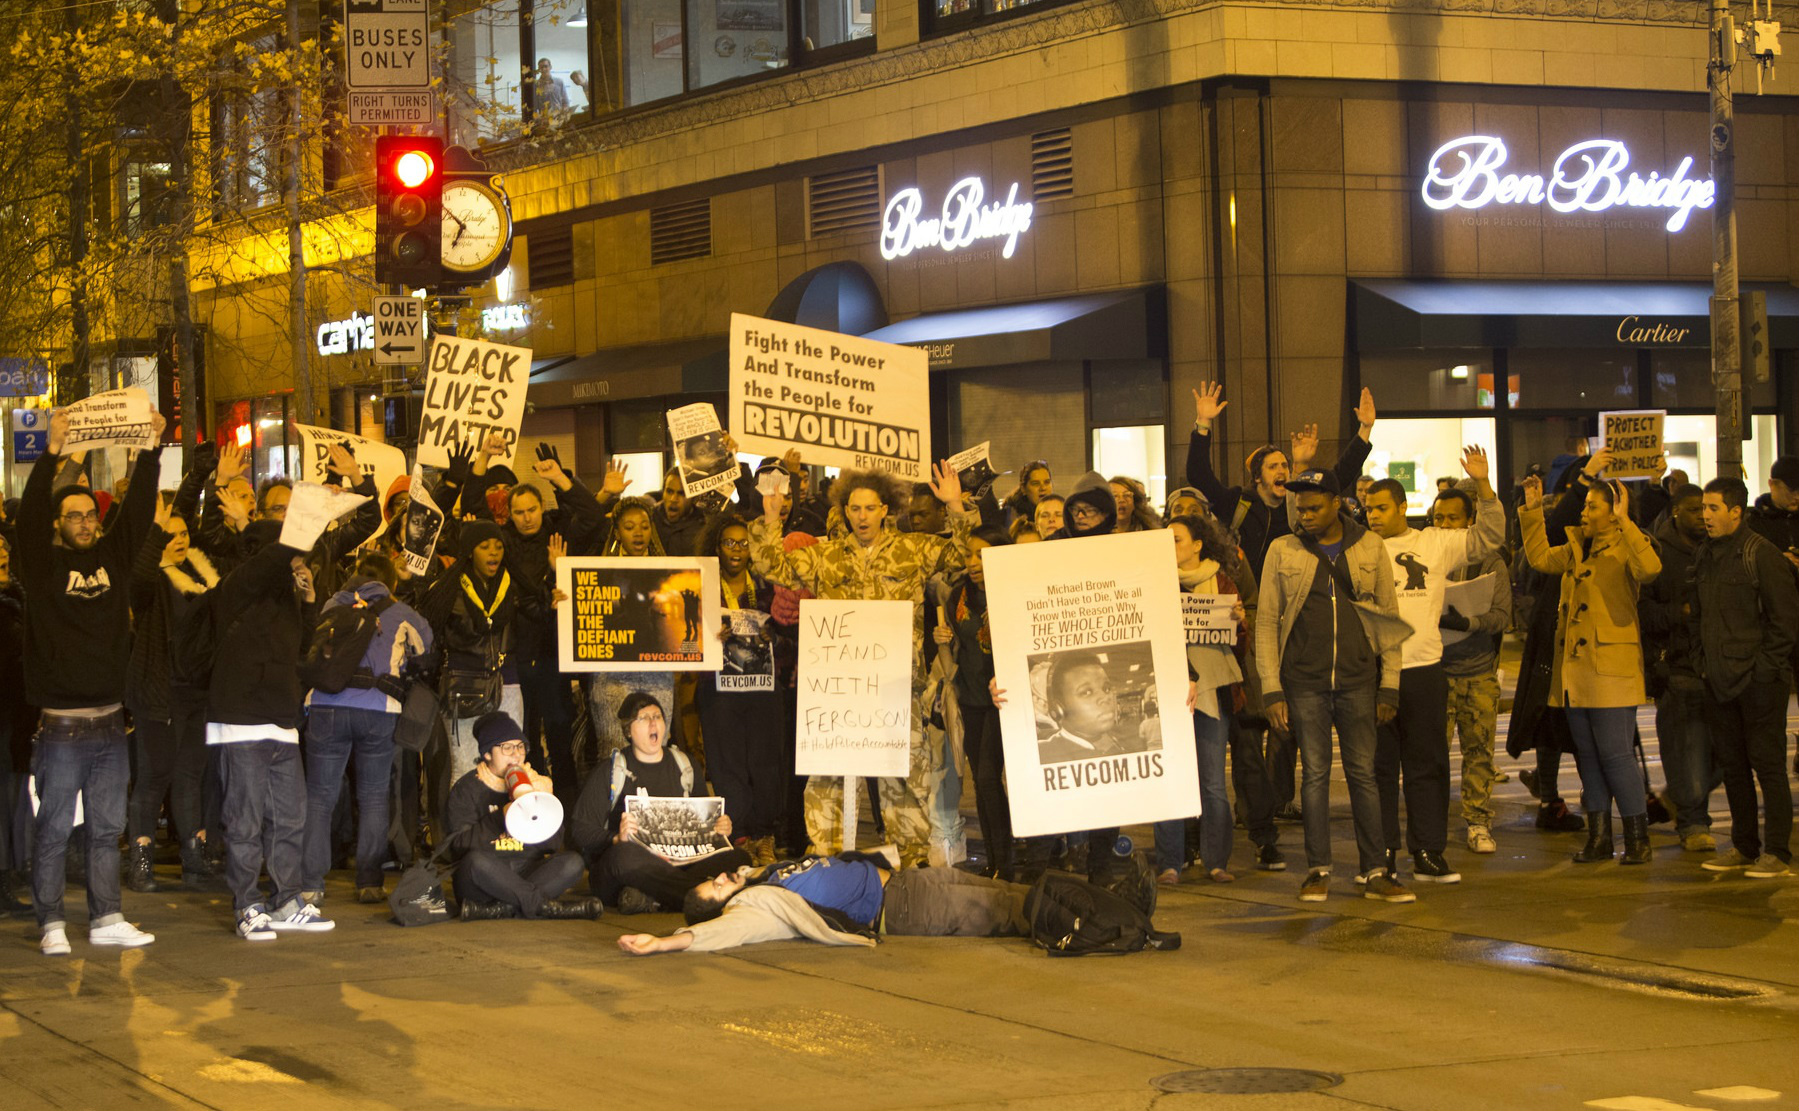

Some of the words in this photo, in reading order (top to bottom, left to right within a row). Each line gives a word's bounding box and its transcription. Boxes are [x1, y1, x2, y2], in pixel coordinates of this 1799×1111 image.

[353, 29, 422, 47] BUSES
[361, 51, 415, 68] ONLY
[353, 96, 384, 107] RIGHT
[392, 95, 427, 107] TURNS
[361, 109, 420, 120] PERMITTED
[1421, 135, 1545, 210] Ben
[1547, 139, 1716, 232] Bridge
[880, 188, 940, 260] Ben
[939, 177, 1033, 259] Bridge
[1460, 218, 1489, 227] YOUR
[1494, 218, 1549, 228] PERSONAL
[1553, 219, 1599, 229] JEWELER
[1604, 219, 1634, 229] SINCE
[379, 301, 417, 317] ONE
[379, 321, 418, 336] WAY
[1616, 315, 1690, 343] Cartier
[745, 330, 788, 353] Fight
[795, 339, 823, 358] the
[831, 345, 885, 370] Power
[432, 342, 521, 383] BLACK
[744, 356, 778, 375] And
[785, 362, 875, 392] Transform
[426, 377, 508, 420] LIVES
[744, 380, 773, 398] the
[781, 386, 842, 411] People
[849, 396, 873, 415] for
[85, 401, 127, 412] Transform
[84, 415, 113, 427] People
[115, 414, 128, 422] for
[1606, 417, 1655, 435] PROTECT
[25, 433, 36, 449] 2
[746, 405, 918, 460] REVOLUTION
[856, 454, 919, 478] REVCOM.US
[688, 469, 738, 494] REVCOM.US
[576, 571, 598, 586] WE
[576, 586, 620, 600] STAND
[1047, 582, 1083, 595] Michael
[1086, 580, 1116, 591] Brown
[1026, 598, 1054, 611] Didn't
[1057, 597, 1080, 607] Have
[1082, 595, 1092, 604] to
[1094, 592, 1112, 603] Die,
[1114, 589, 1129, 600] We
[1131, 587, 1142, 598] all
[1187, 596, 1215, 604] Power
[577, 601, 613, 615] WITH
[1032, 612, 1059, 623] Know
[1062, 609, 1077, 620] the
[1079, 605, 1114, 617] Reason
[1116, 602, 1137, 613] Why
[577, 615, 604, 629] THE
[809, 610, 855, 640] WE
[1031, 622, 1055, 637] THE
[1058, 616, 1104, 634] WHOLE
[1107, 612, 1143, 628] DAMN
[1196, 617, 1209, 626] for
[578, 630, 636, 644] DEFIANT
[1033, 633, 1083, 651] SYSTEM
[1087, 631, 1098, 644] IS
[1101, 625, 1145, 642] GUILTY
[1184, 630, 1230, 644] LUTION
[578, 645, 614, 659] ONES
[639, 653, 702, 661] revcom.us
[808, 643, 888, 665] STAND
[721, 676, 772, 688] REVCOM.US
[807, 674, 879, 696] WITH
[1043, 753, 1164, 792] REVCOM.US
